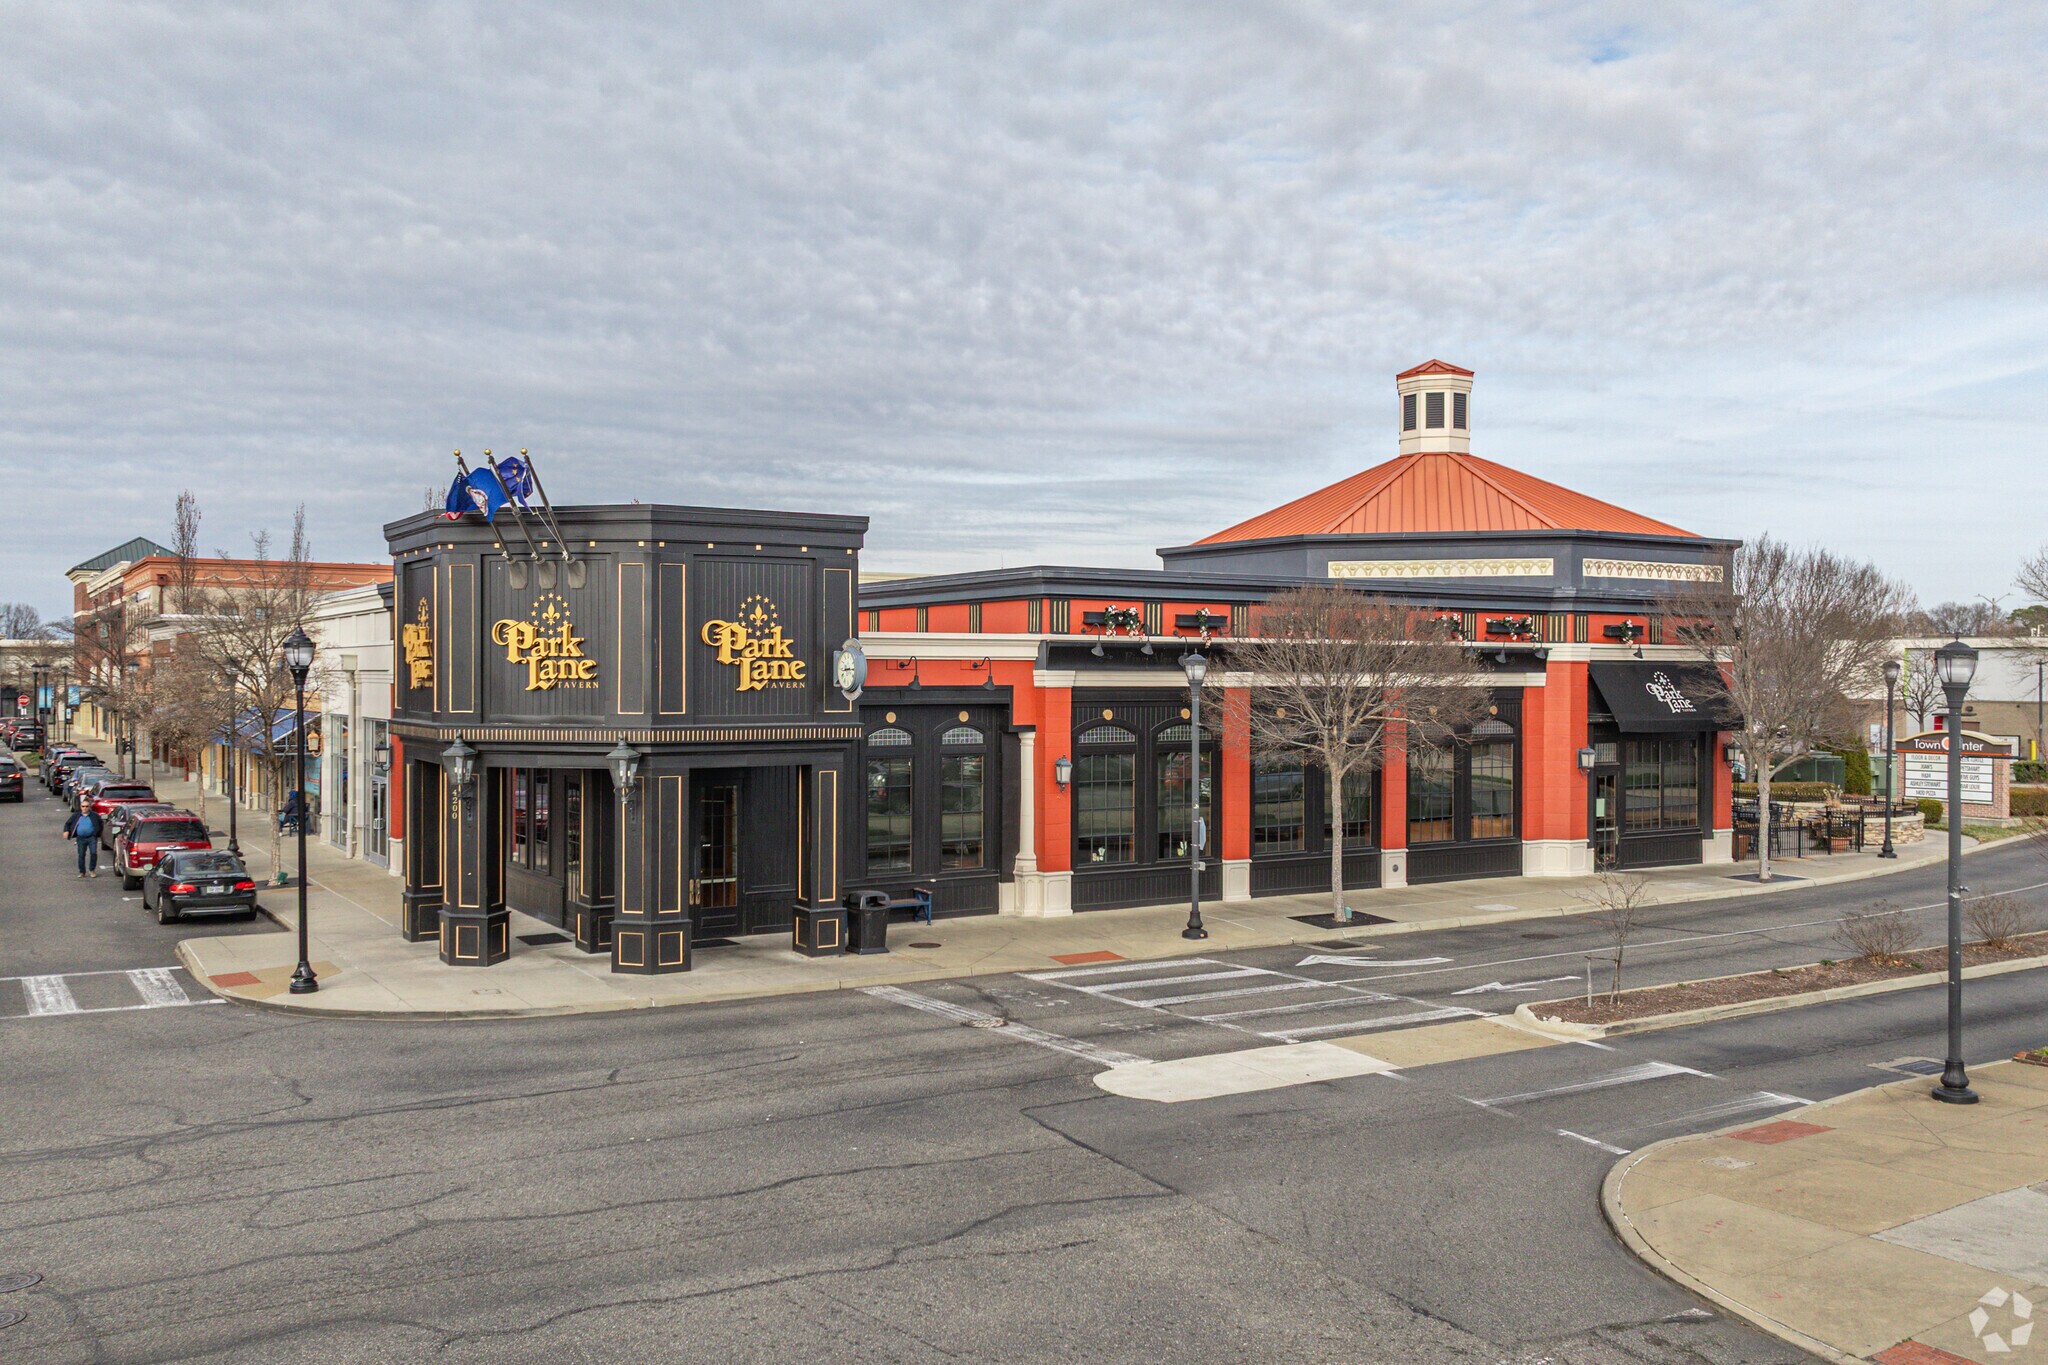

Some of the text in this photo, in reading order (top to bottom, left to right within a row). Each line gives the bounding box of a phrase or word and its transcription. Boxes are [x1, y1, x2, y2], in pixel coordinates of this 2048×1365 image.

[492, 619, 585, 664] Park
[701, 619, 795, 665] Park
[525, 656, 598, 691] Lane
[558, 681, 599, 689] TAVERN
[736, 657, 806, 691] Lane
[766, 681, 805, 689] TAVERN
[1646, 683, 1684, 702] Park
[1914, 739, 1941, 750] Town
